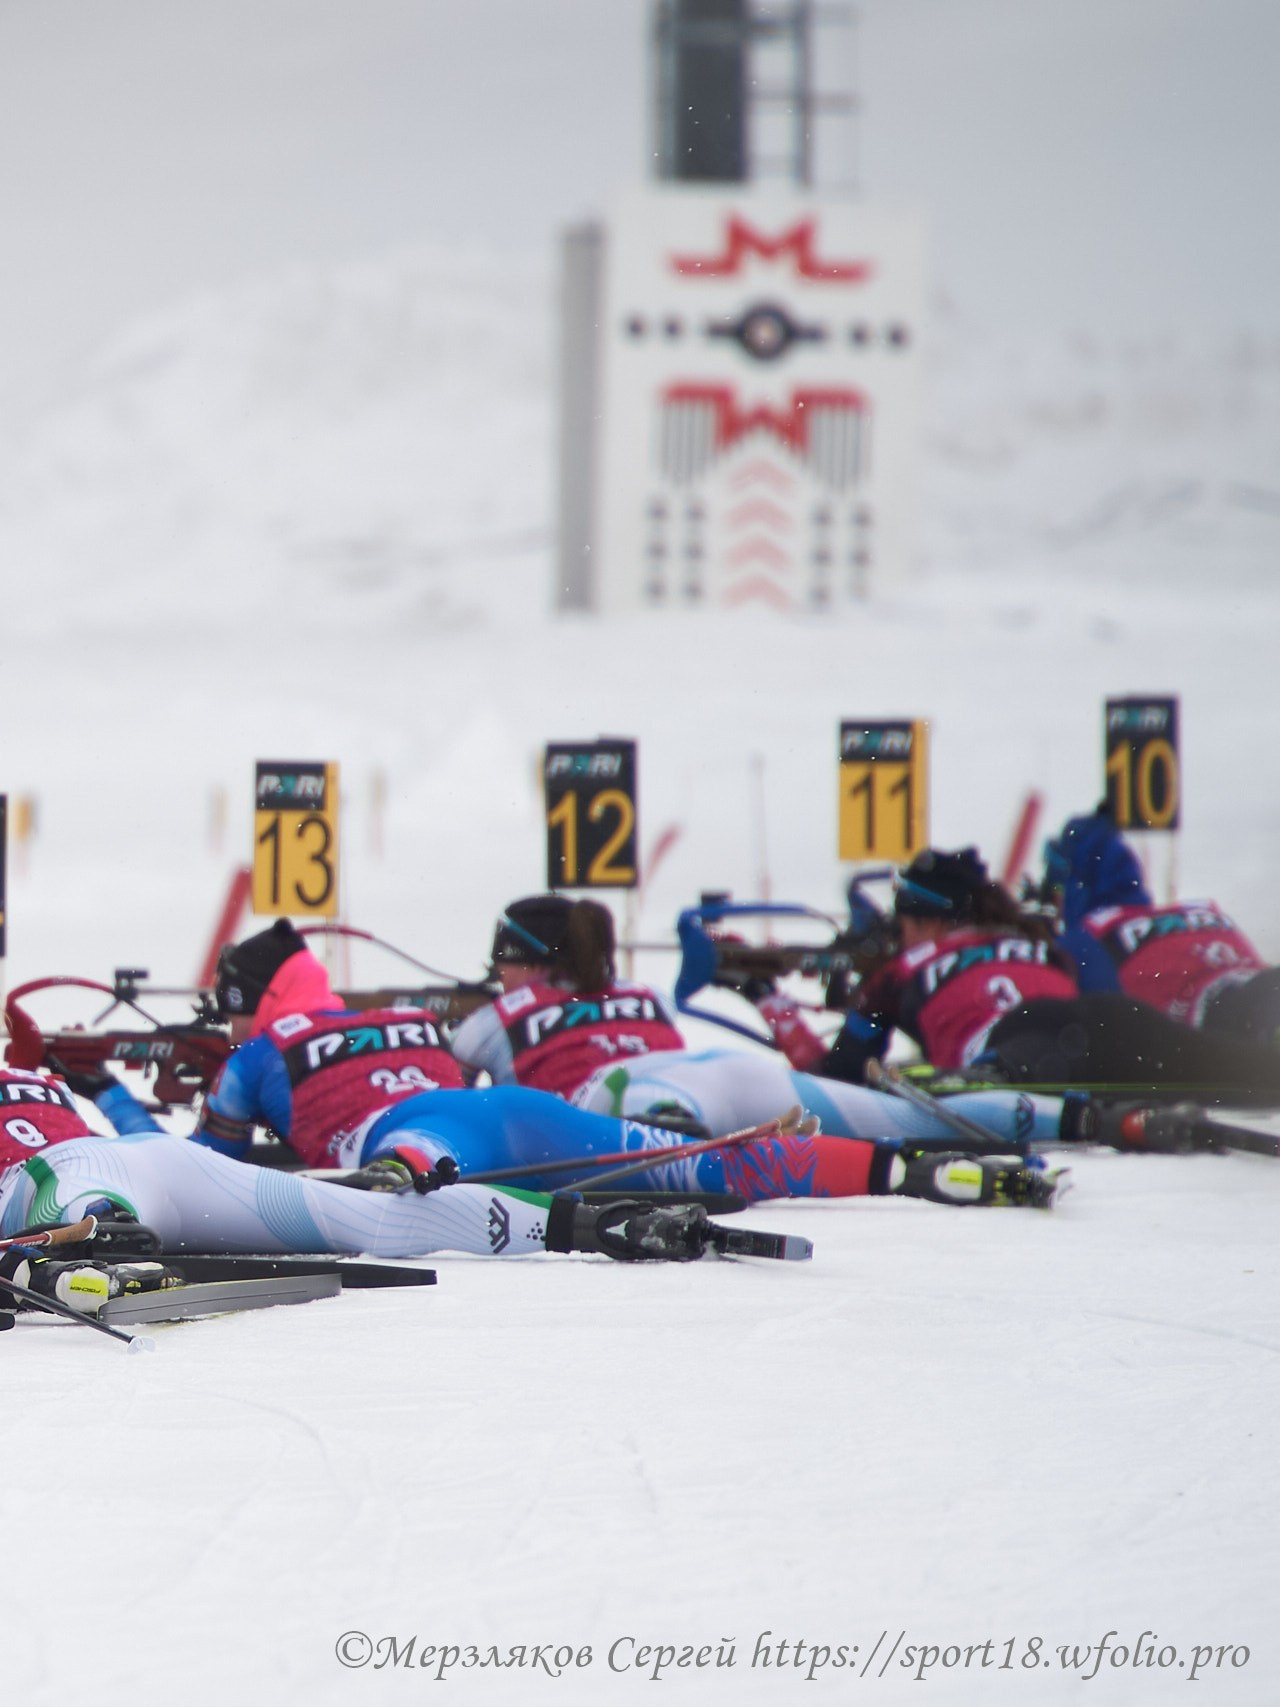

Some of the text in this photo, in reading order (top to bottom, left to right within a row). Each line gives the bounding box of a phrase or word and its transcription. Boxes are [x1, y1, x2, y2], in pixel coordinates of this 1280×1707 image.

[850, 768, 913, 851] 11
[1106, 739, 1177, 829] 10
[257, 812, 334, 907] 13
[548, 788, 634, 885] 12
[307, 1022, 440, 1069] PARI
[527, 998, 656, 1046] PARI
